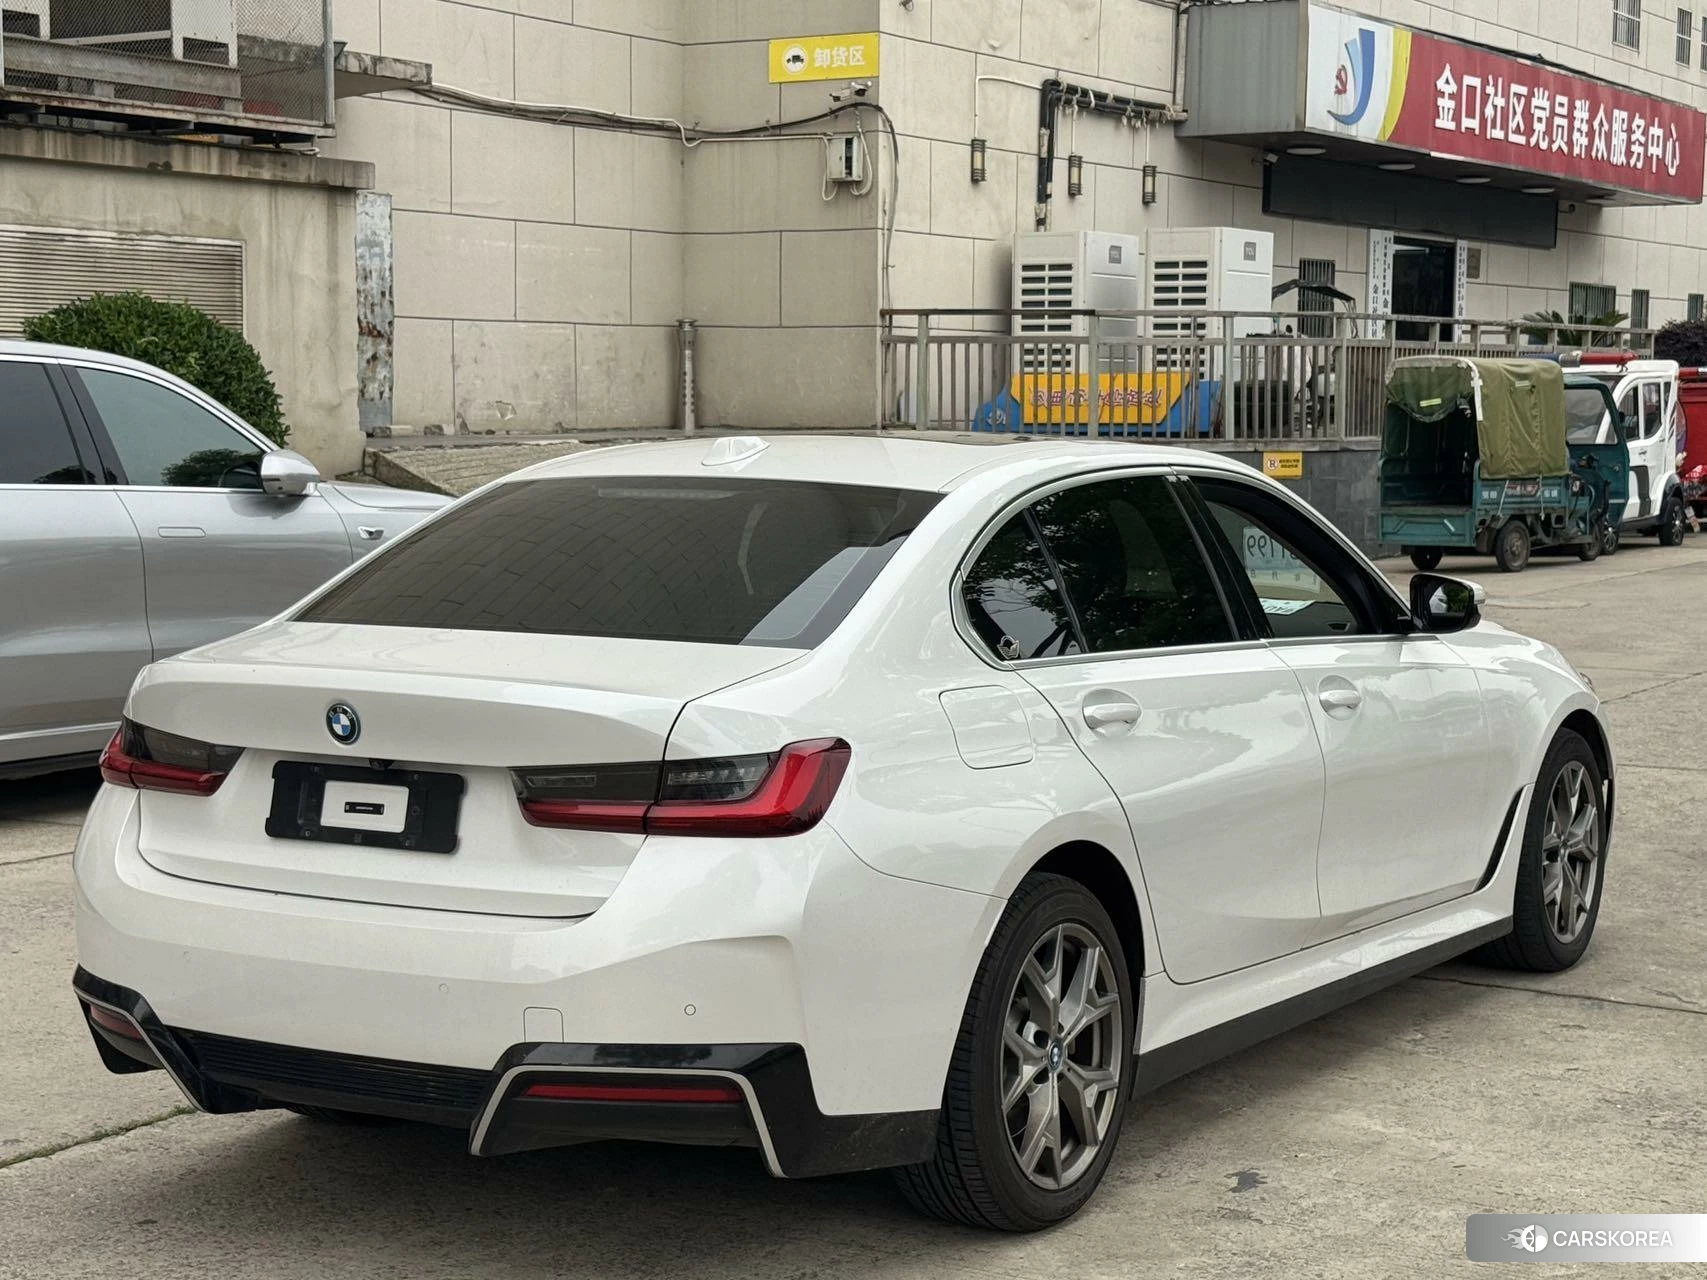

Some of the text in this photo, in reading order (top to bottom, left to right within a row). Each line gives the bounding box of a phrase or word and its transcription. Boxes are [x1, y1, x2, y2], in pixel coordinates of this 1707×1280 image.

[814, 46, 865, 68] 卸货区
[1434, 62, 1681, 176] 金口社区党员群众服务中心
